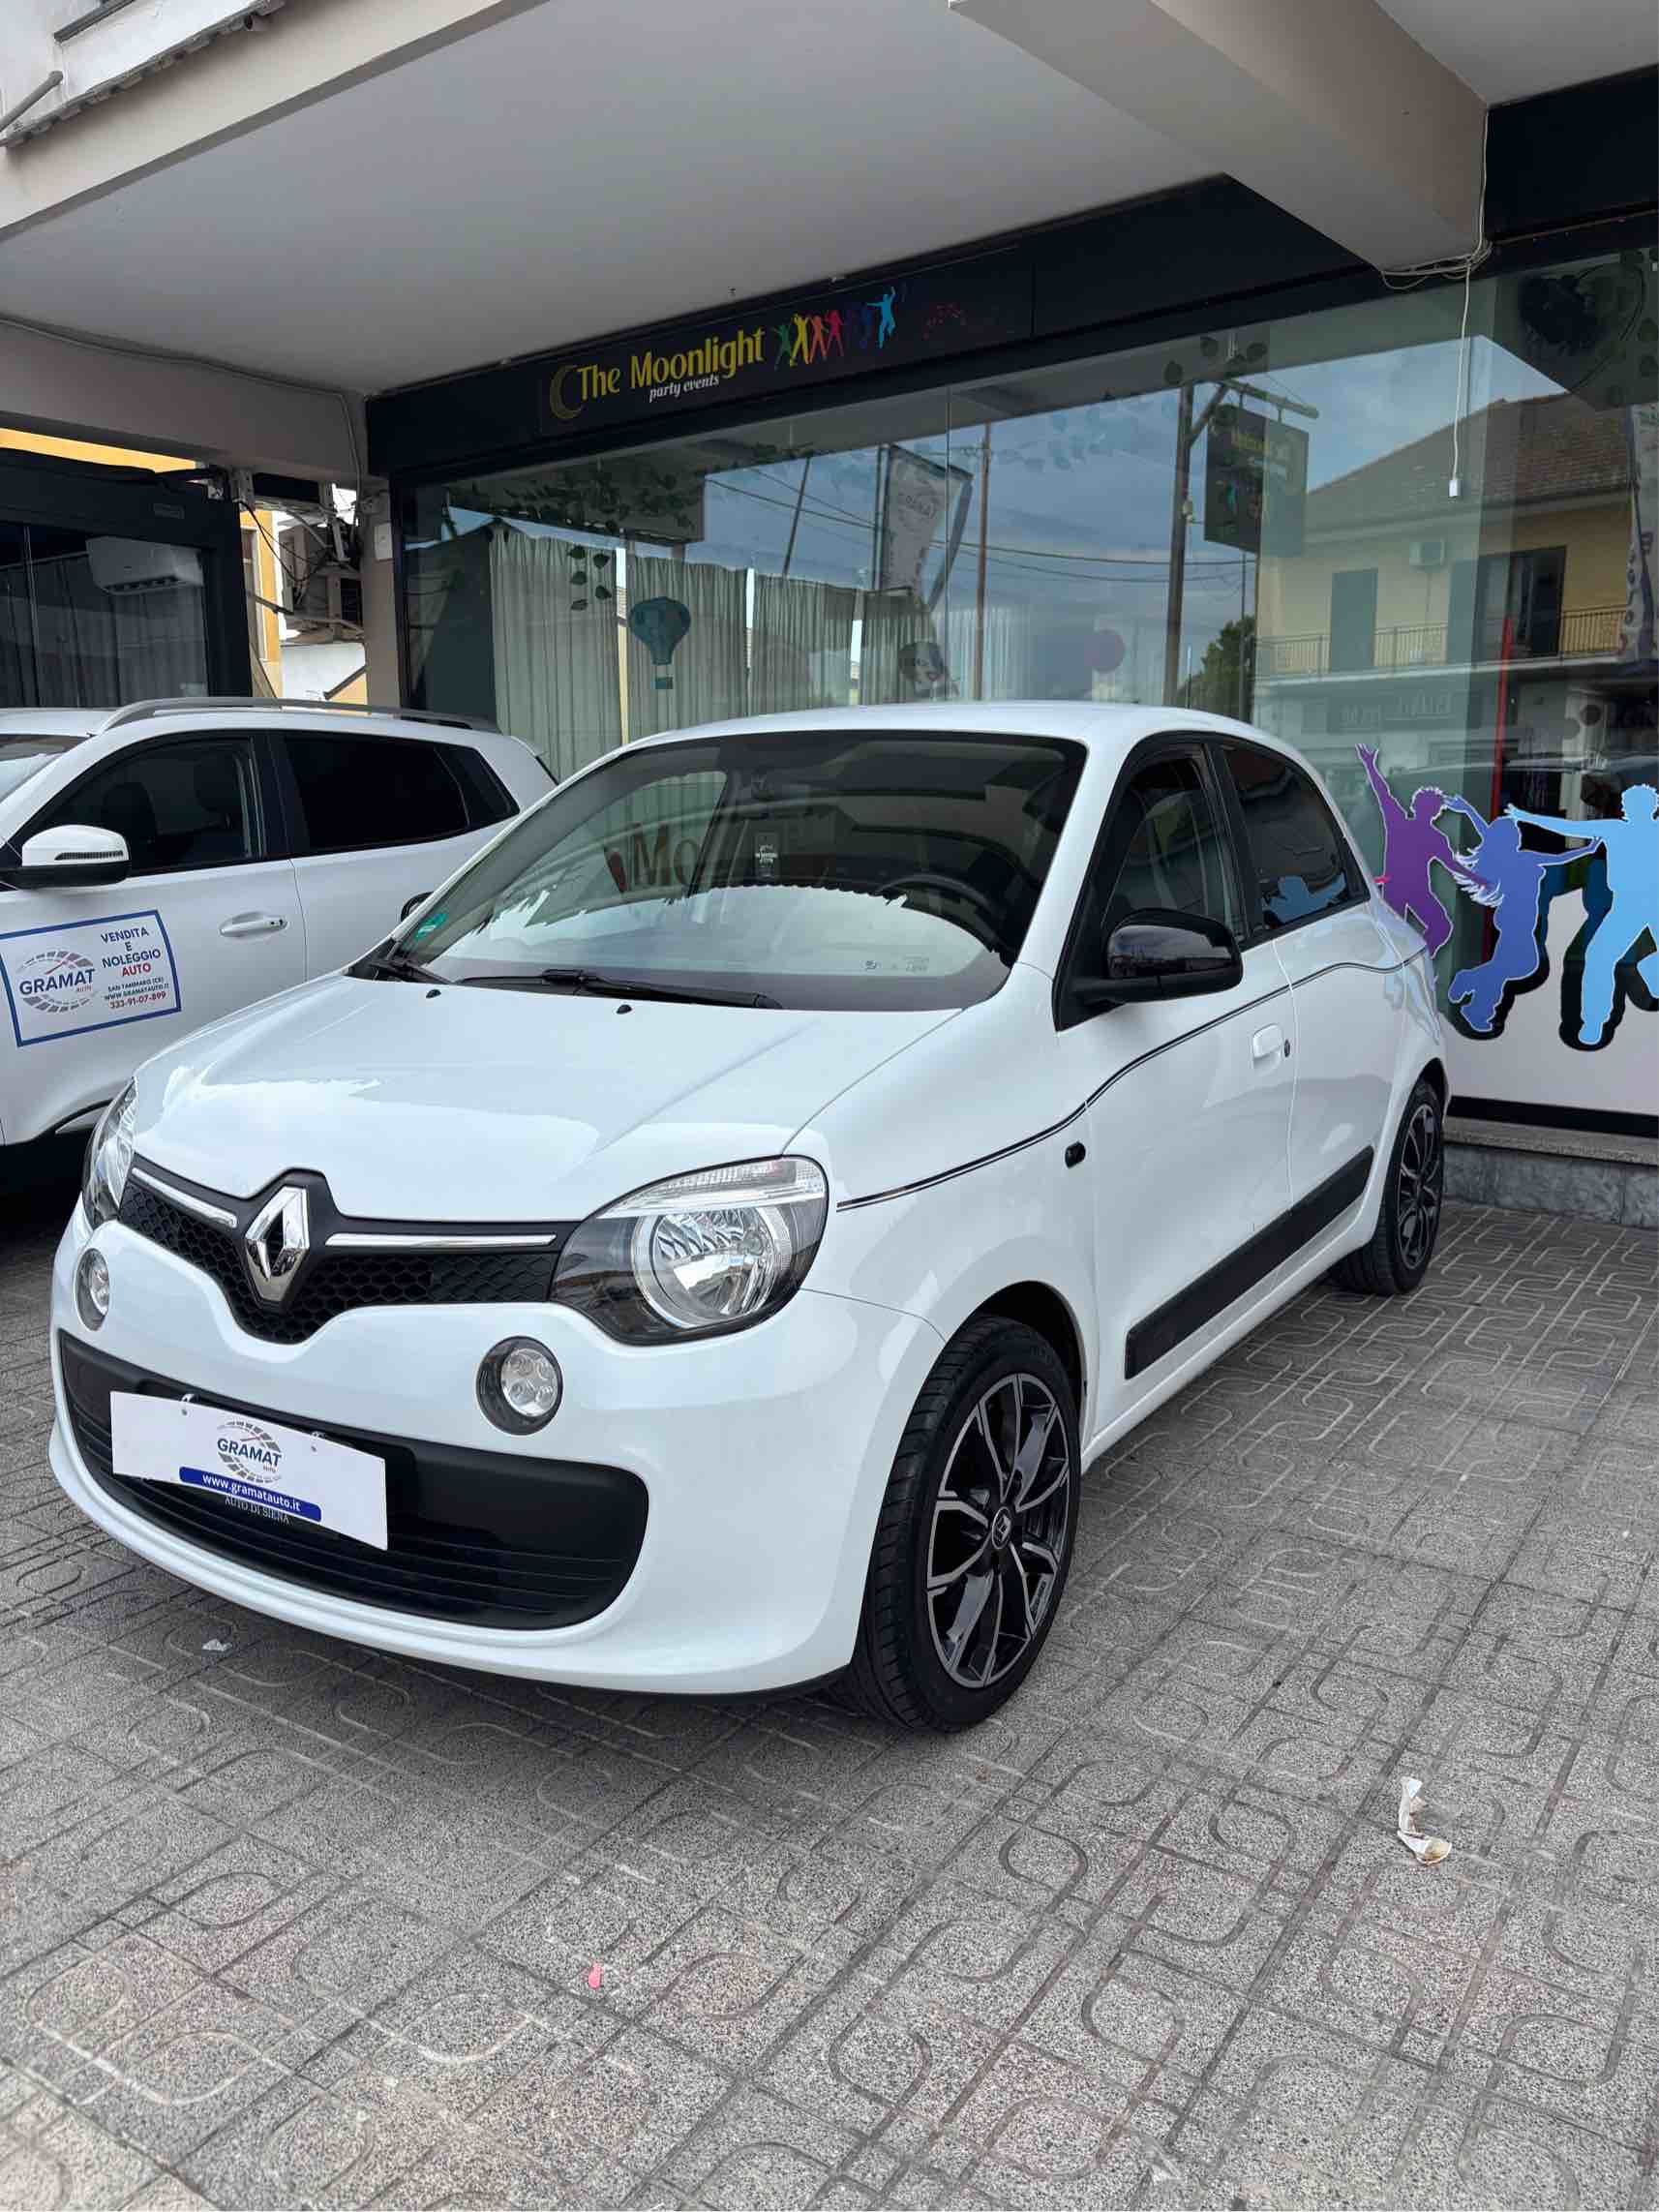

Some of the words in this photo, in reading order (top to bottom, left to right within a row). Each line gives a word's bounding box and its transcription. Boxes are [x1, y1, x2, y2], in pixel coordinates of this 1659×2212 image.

[577, 366, 620, 401] The
[629, 327, 766, 390] Moonlight
[649, 381, 681, 403] party
[683, 374, 720, 393] events
[101, 926, 150, 944] VENDITA
[125, 941, 133, 952] E
[102, 949, 162, 969] NOLEGGIO
[121, 962, 152, 978] AUTO
[19, 968, 96, 995] GRAMAT
[217, 1438, 282, 1468] GRAMAT
[202, 1473, 301, 1511] www.gramatauto.it
